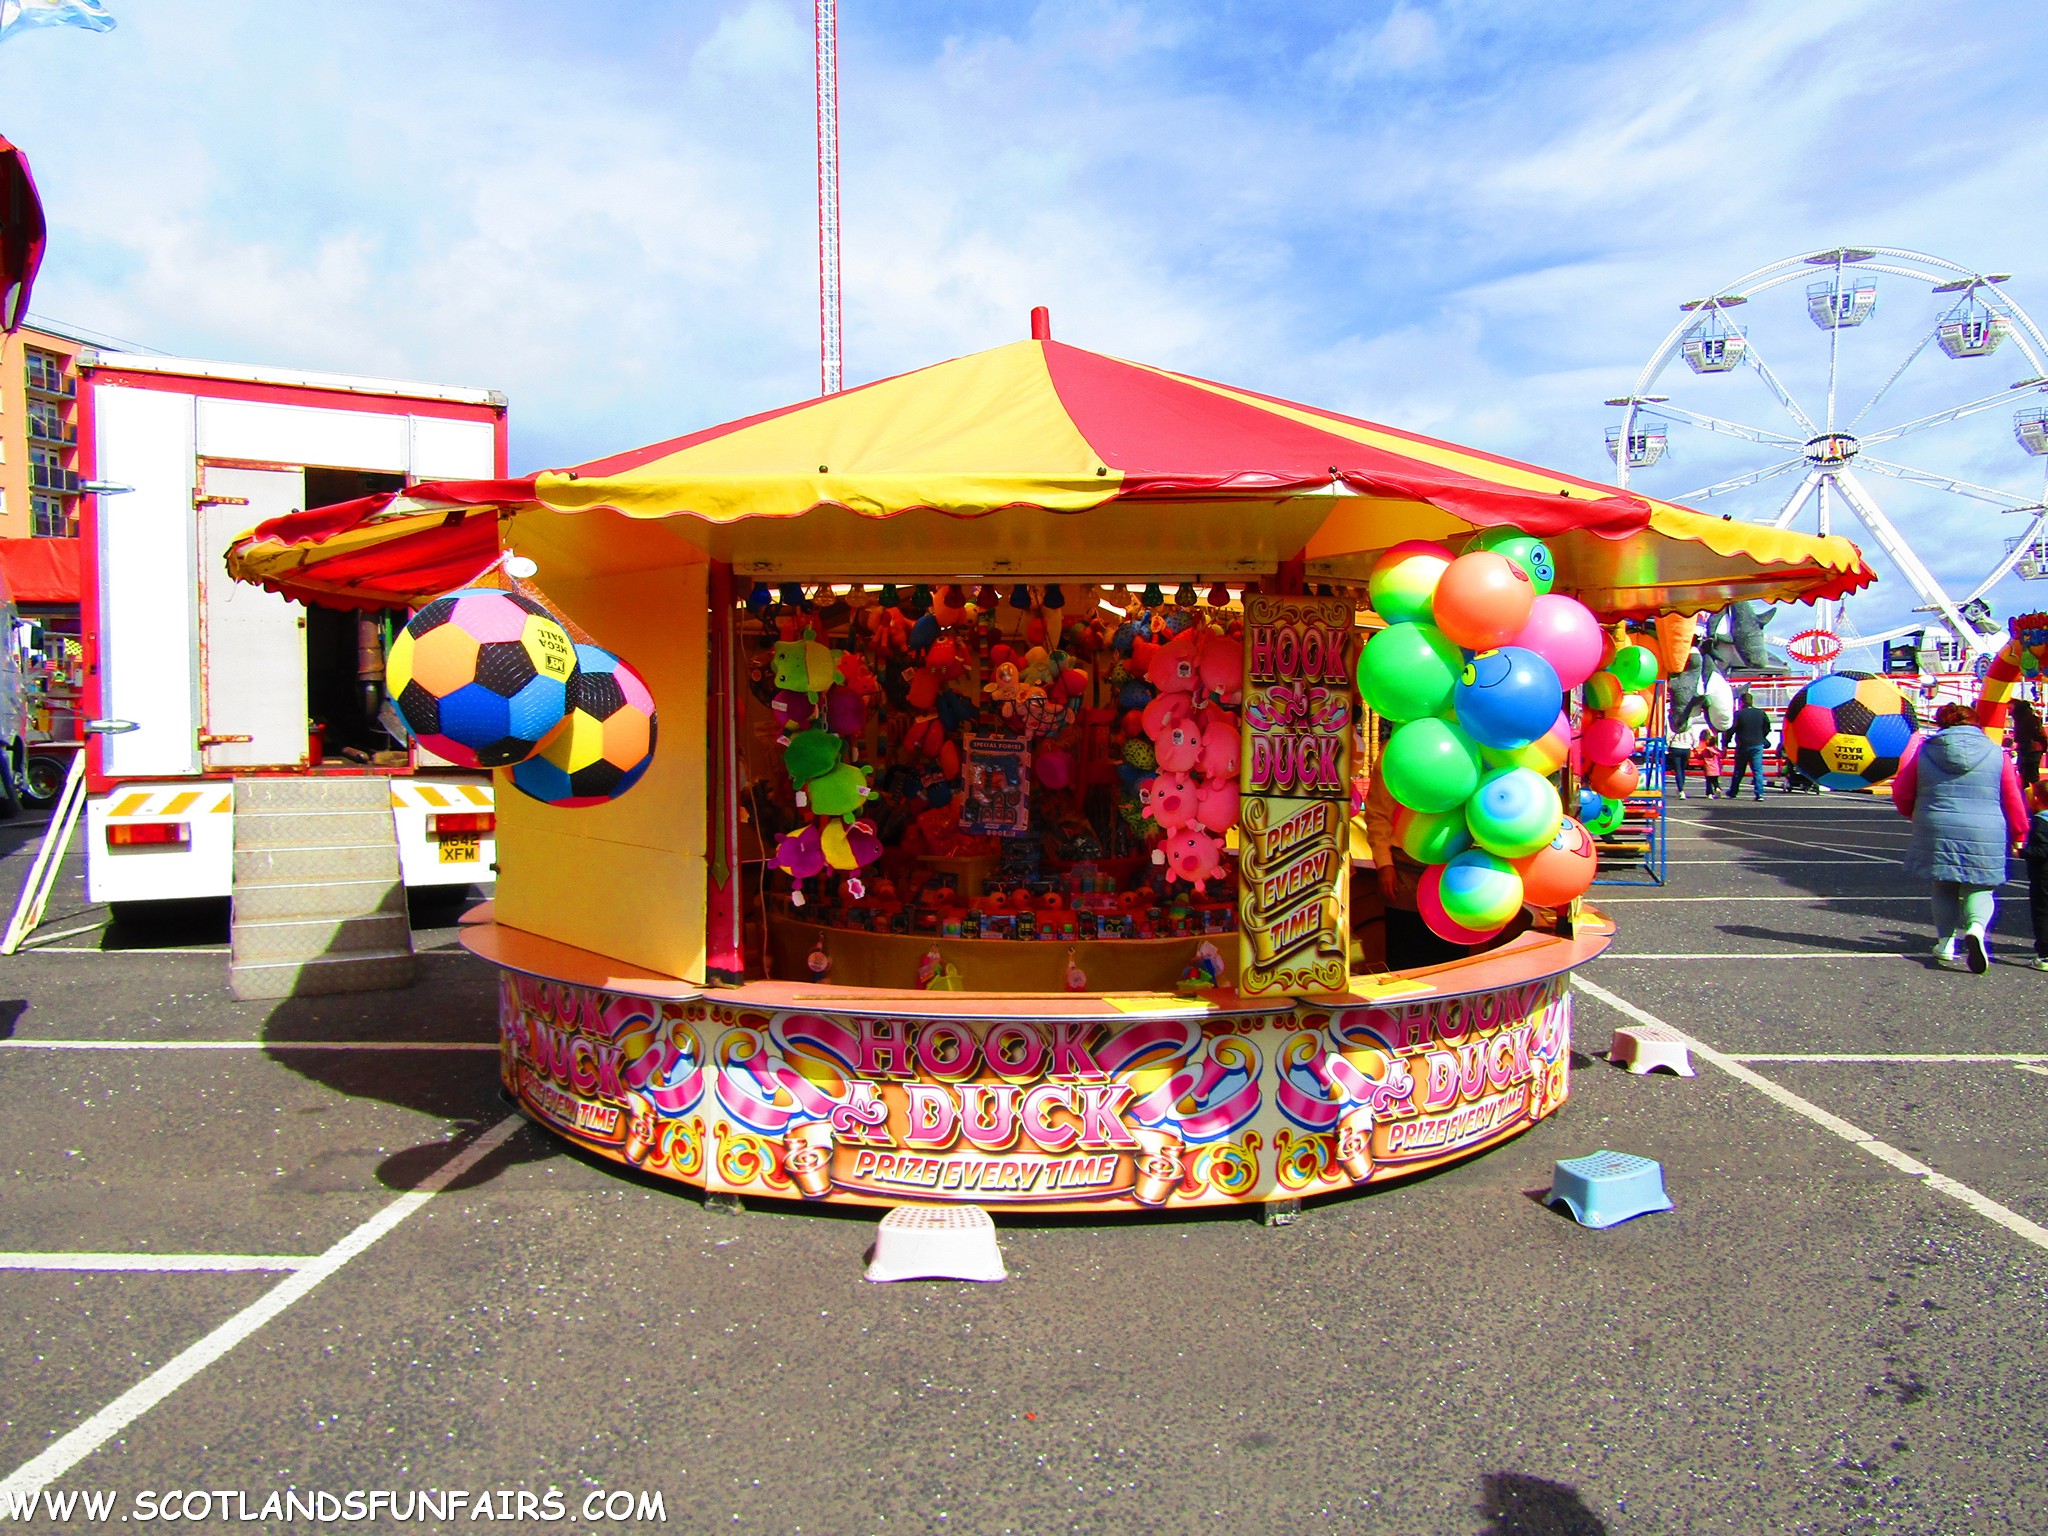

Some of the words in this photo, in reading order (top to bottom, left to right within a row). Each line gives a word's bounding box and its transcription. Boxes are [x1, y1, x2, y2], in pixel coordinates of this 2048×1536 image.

[537, 629, 564, 643] BALL
[538, 639, 568, 655] MEGA
[1249, 623, 1347, 684] HOOK
[1250, 732, 1342, 793] DUCK
[1834, 752, 1864, 761] MEGA
[1836, 746, 1863, 754] BALL
[444, 847, 475, 860] XFM
[1266, 803, 1328, 859] PRIZE
[1262, 850, 1328, 908] EVERY
[1270, 901, 1321, 951] TIME
[1392, 987, 1527, 1056] HOOK
[852, 1017, 1112, 1084] HOOK
[1371, 1057, 1420, 1123] A
[1423, 1022, 1534, 1114] DUCK
[577, 1102, 619, 1134] TIME
[832, 1080, 898, 1149] A
[904, 1084, 1141, 1153] DUCK
[1388, 1116, 1448, 1153] PRIZE
[1447, 1101, 1498, 1144] EVERY
[1494, 1083, 1526, 1126] TIME
[853, 1150, 939, 1186] PRIZE
[943, 1159, 1042, 1192] EVERY
[1046, 1154, 1120, 1189] TIME
